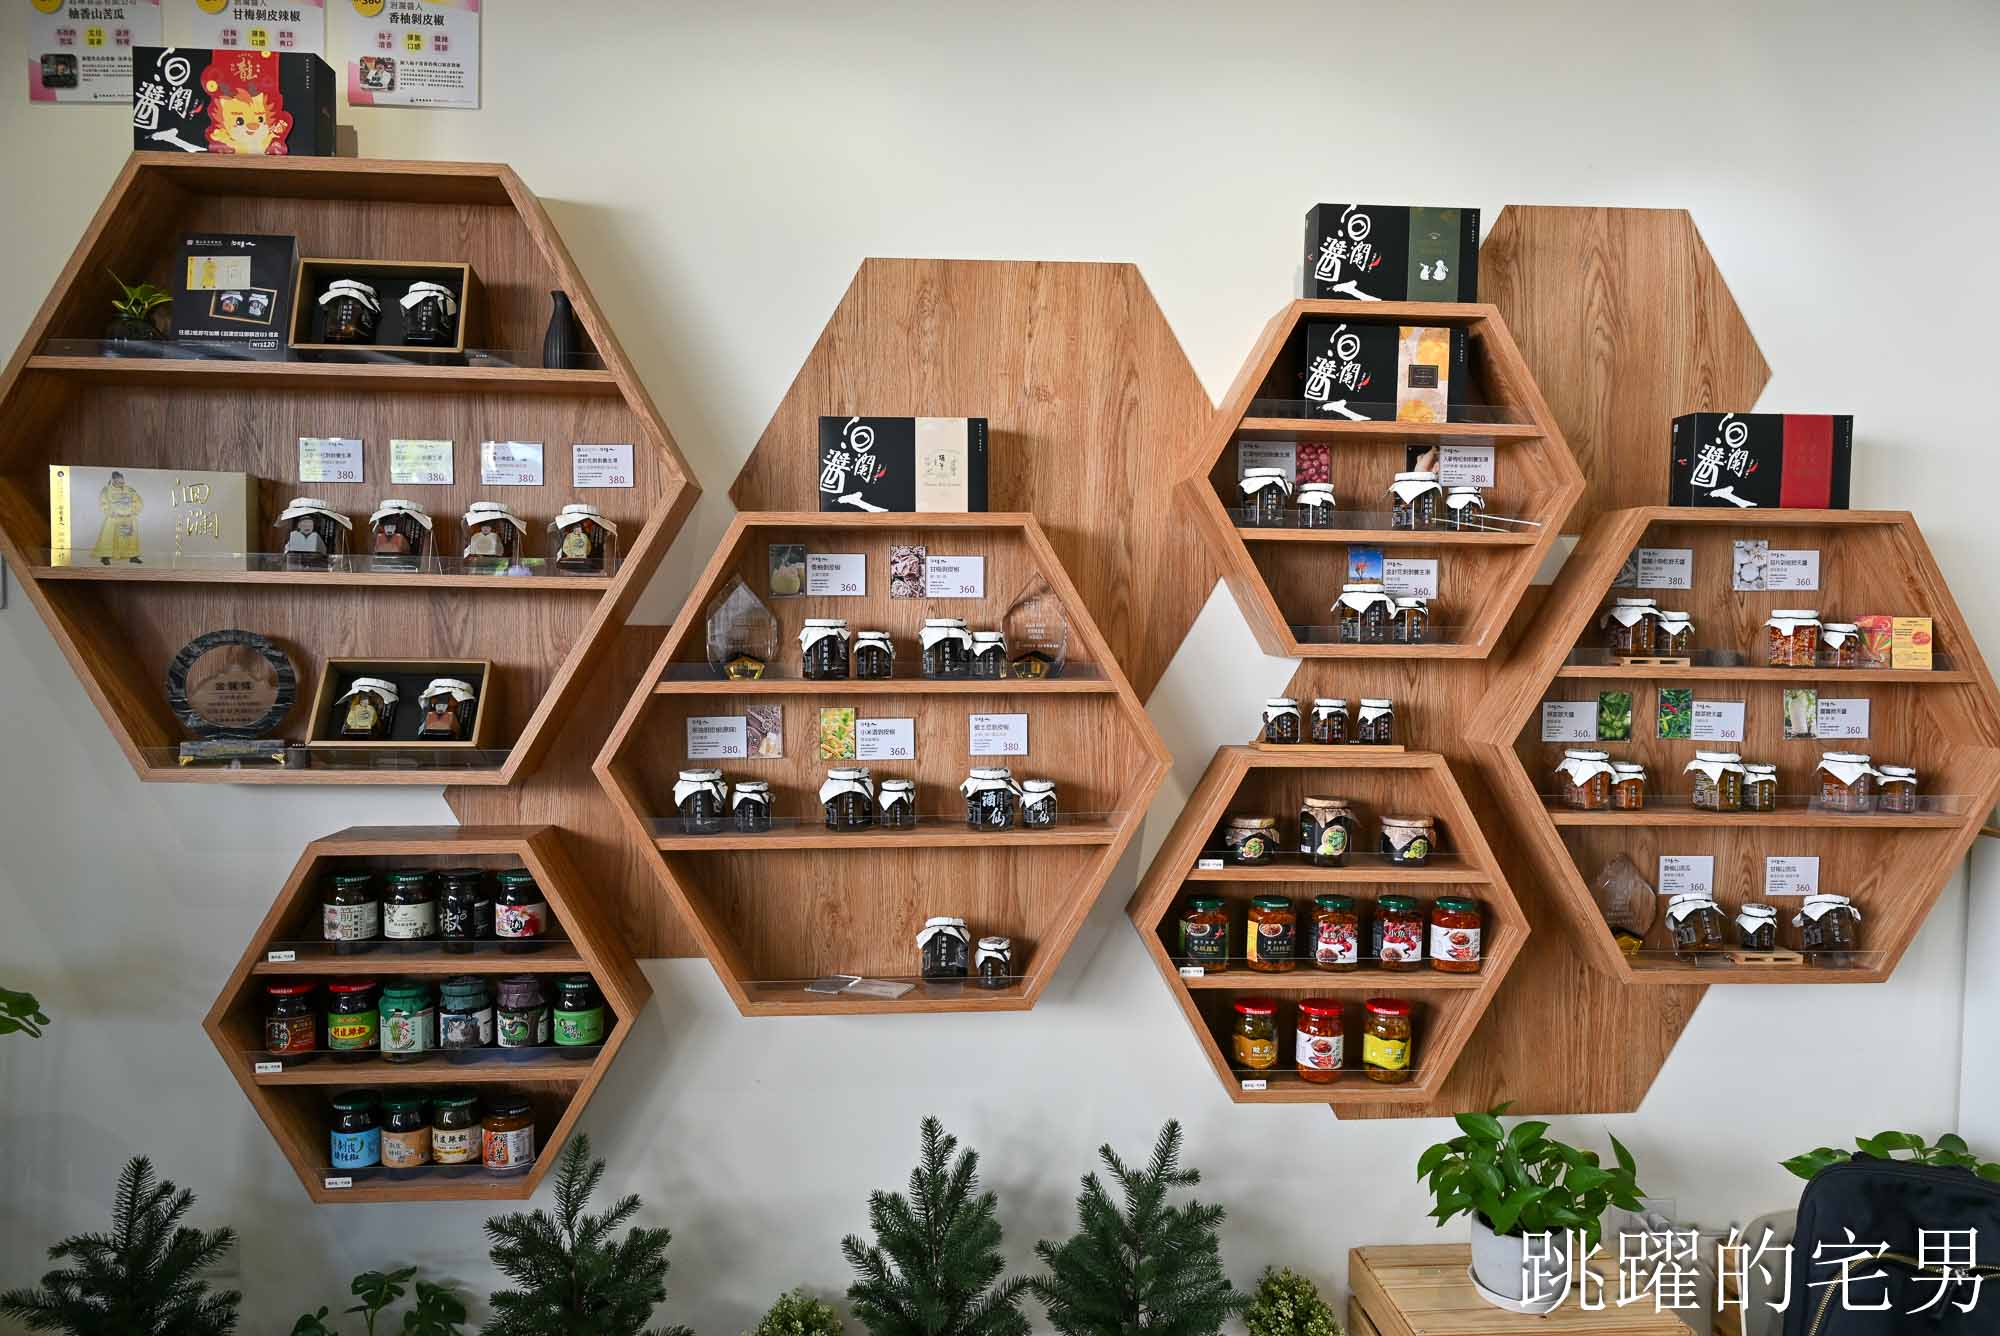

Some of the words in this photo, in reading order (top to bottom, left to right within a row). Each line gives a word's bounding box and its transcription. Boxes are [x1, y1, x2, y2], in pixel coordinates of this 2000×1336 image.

[69, 8, 125, 20] 柚香山苦瓜
[233, 8, 301, 22] 甘梅剝皮辣椒
[390, 12, 445, 26] 香柚剝皮椒
[336, 470, 354, 480] 380
[427, 471, 445, 481] 380
[518, 474, 534, 483] 380
[608, 475, 625, 484] 380
[1471, 474, 1486, 483] 380
[1668, 577, 1683, 585] 380
[1796, 577, 1811, 586] 360
[840, 583, 857, 592] 360
[959, 585, 975, 594] 360
[1413, 588, 1429, 596] 360
[1573, 729, 1588, 738] 360
[1720, 729, 1736, 738] 360
[1847, 726, 1861, 735] 360
[722, 745, 738, 754] 380
[1003, 742, 1019, 751] 380
[889, 747, 906, 756] 360
[982, 791, 1006, 827] 酒仙
[1689, 883, 1704, 891] 360
[1796, 884, 1810, 892] 360
